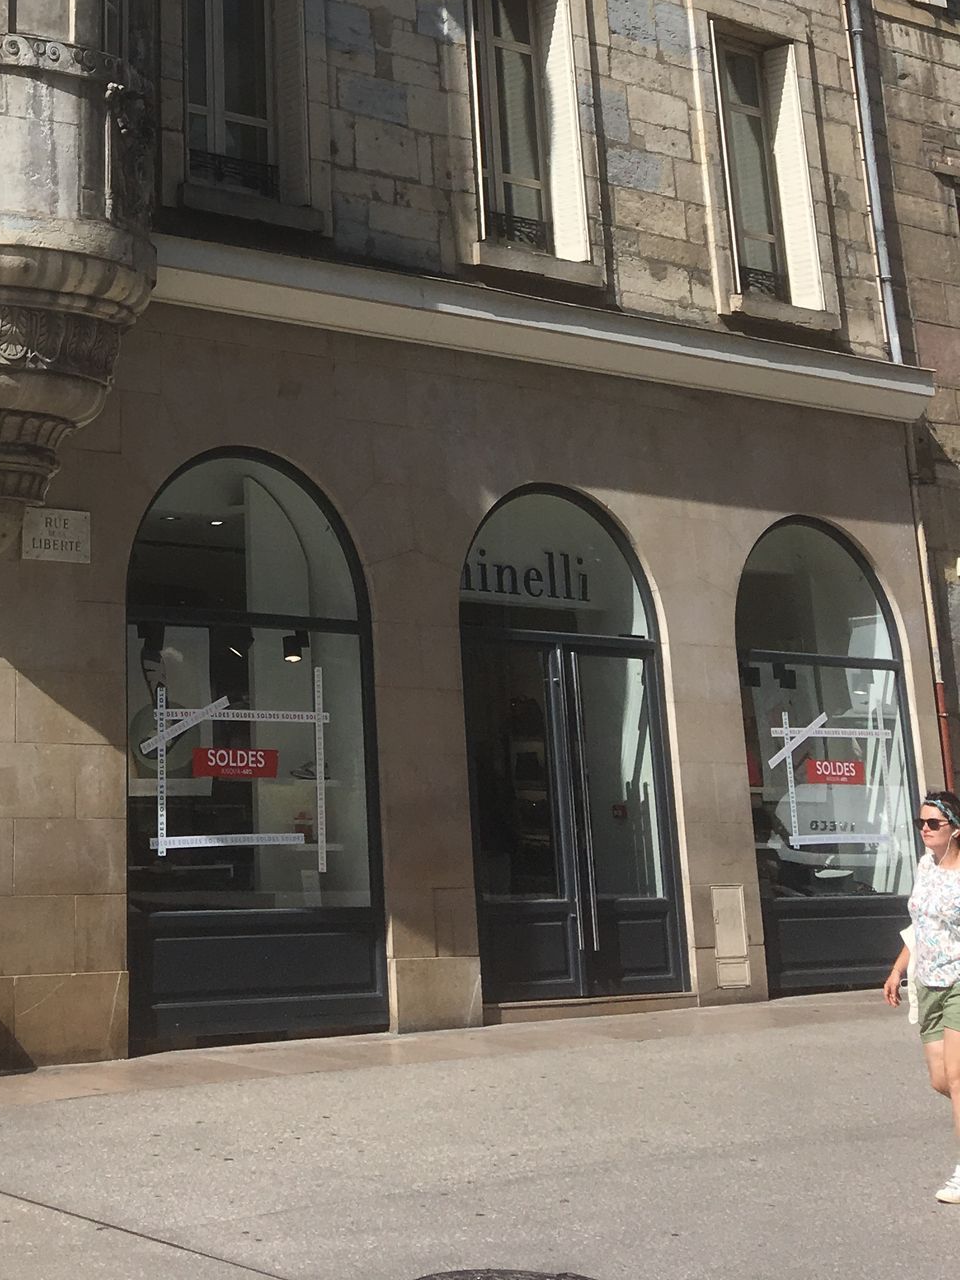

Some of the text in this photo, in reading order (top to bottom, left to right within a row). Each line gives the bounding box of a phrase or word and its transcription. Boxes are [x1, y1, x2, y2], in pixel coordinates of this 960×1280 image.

[45, 517, 69, 529] RUE
[207, 749, 265, 768] SOLDES
[816, 761, 856, 776] SOLDES
